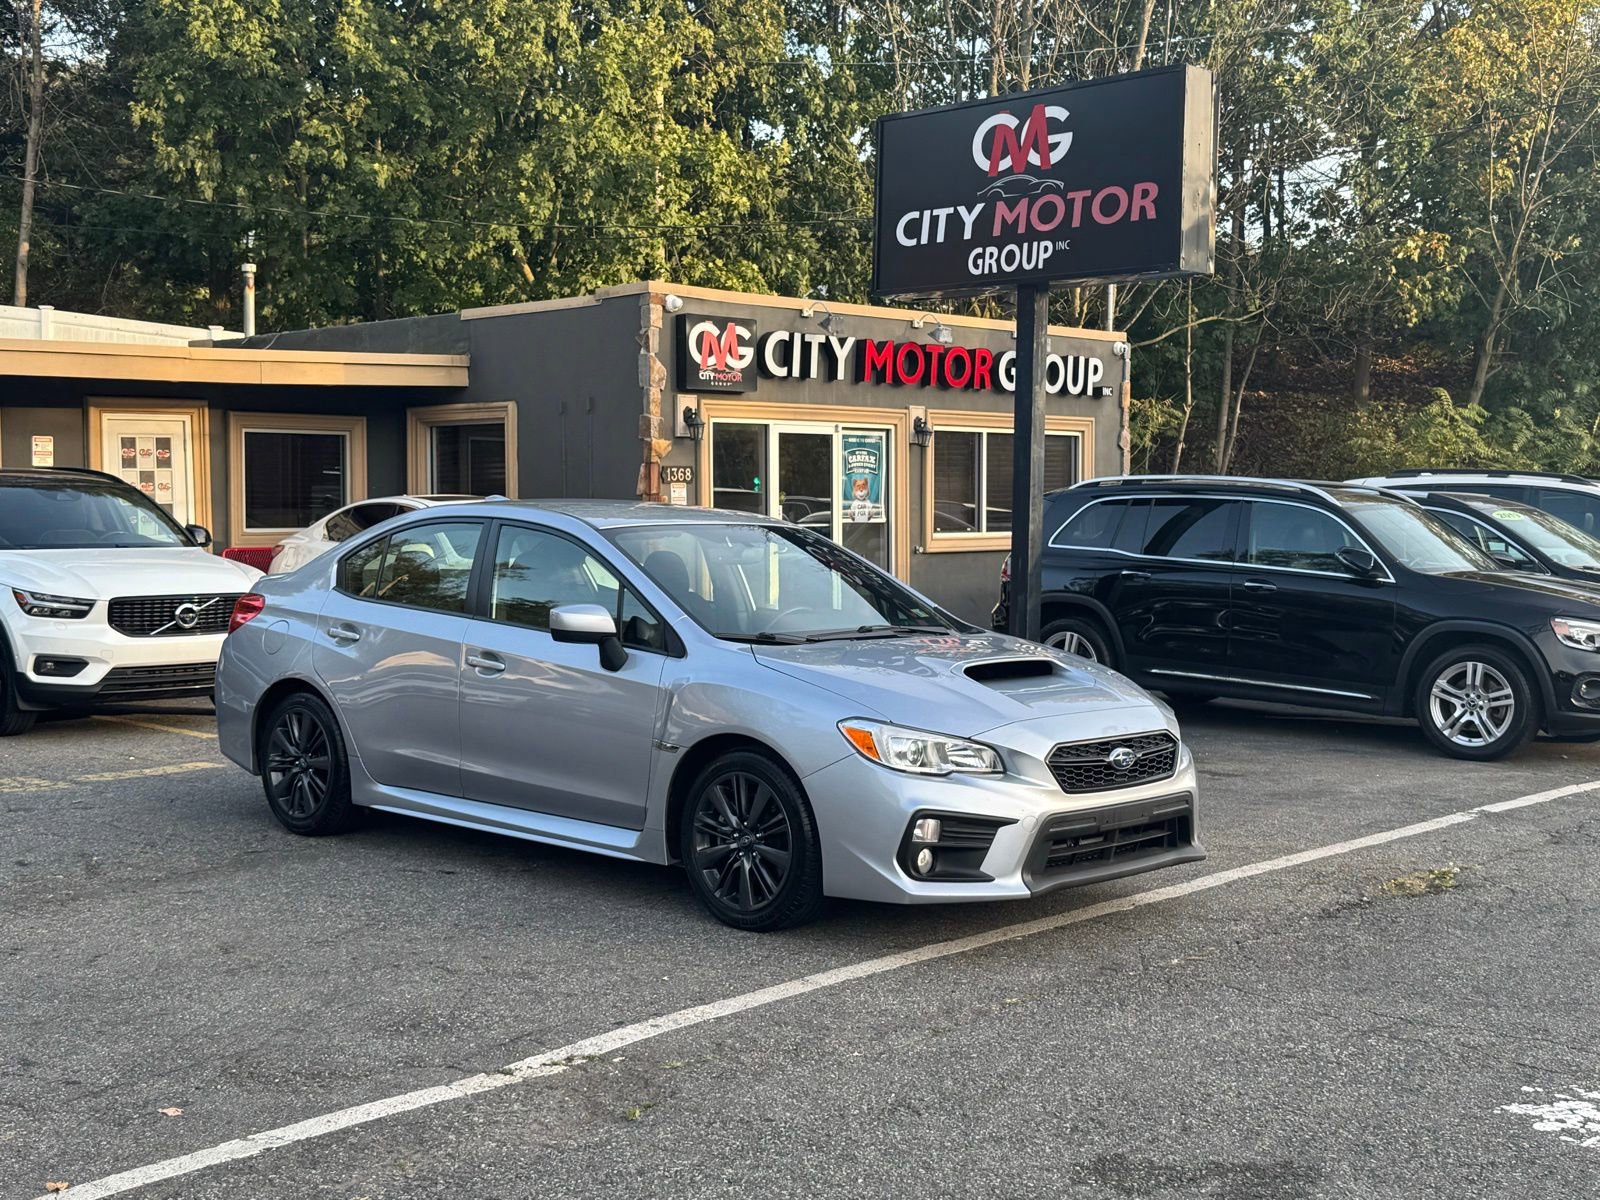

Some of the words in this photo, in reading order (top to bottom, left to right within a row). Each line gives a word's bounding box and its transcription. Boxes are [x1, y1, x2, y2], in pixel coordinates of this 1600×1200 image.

[895, 203, 986, 247] CITY
[992, 182, 1159, 237] MOTOR
[967, 241, 1054, 276] GROUP
[1055, 239, 1071, 251] INC
[764, 330, 856, 381] CITY
[864, 338, 994, 390] MOTOR
[998, 350, 1104, 396] GOUP
[1102, 386, 1113, 397] INC
[666, 467, 692, 482] 1368
[848, 455, 876, 464] CARFAX
